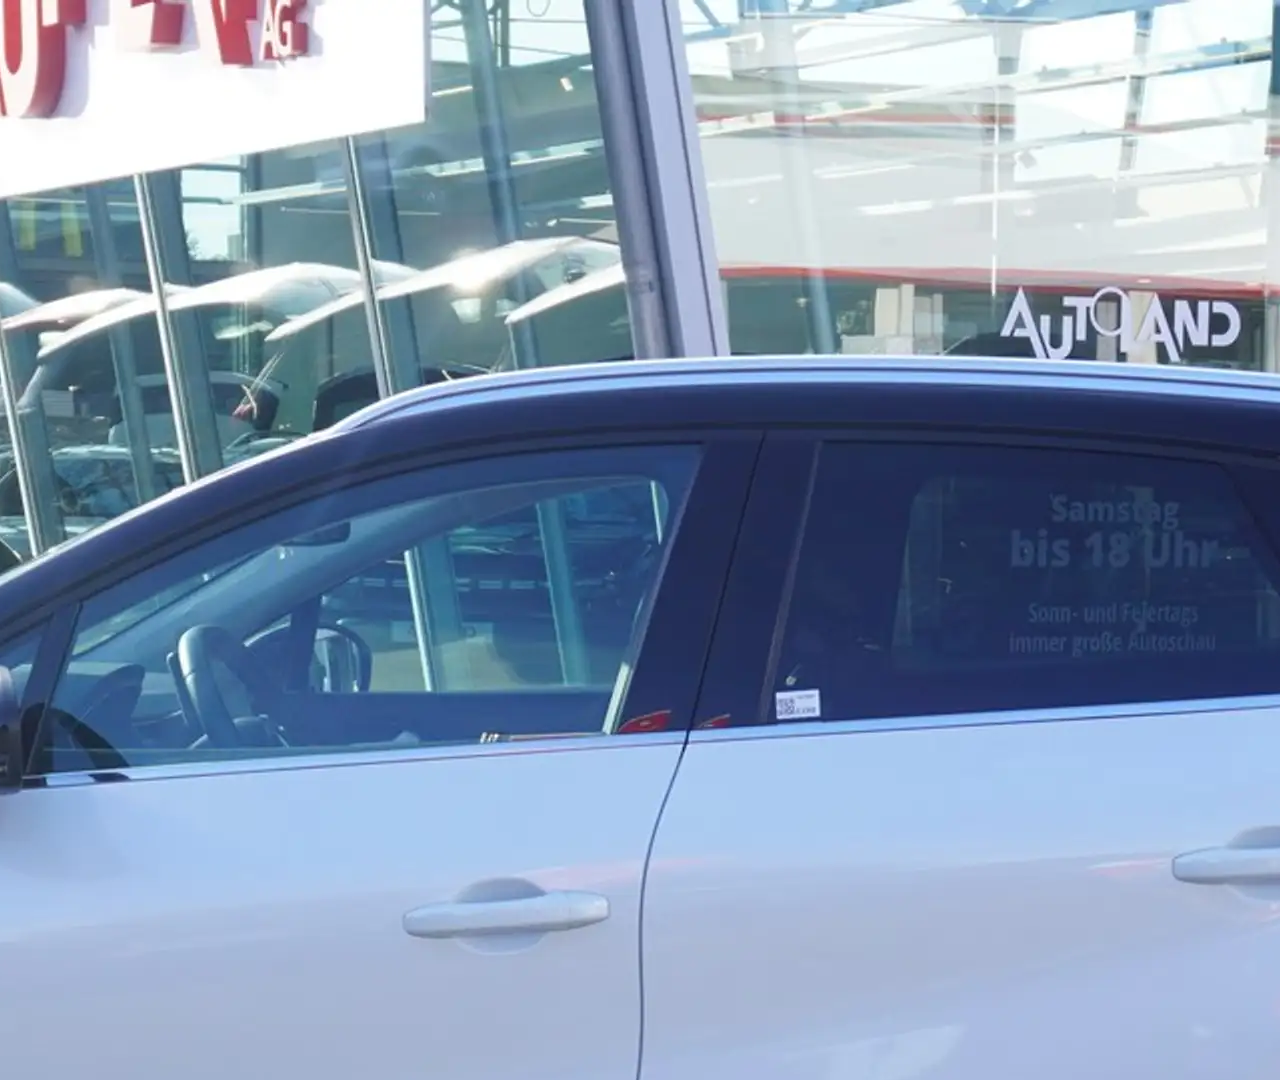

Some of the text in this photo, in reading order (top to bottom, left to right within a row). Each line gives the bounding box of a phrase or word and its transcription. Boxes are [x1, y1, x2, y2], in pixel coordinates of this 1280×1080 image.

[1001, 286, 1241, 361] AUTOLAND
[1049, 491, 1180, 530] Samstag
[1010, 528, 1219, 568] bis 18 Uhr
[1028, 601, 1200, 627] Sonn- und Feiertags
[1008, 631, 1217, 658] immer große Autoschau
